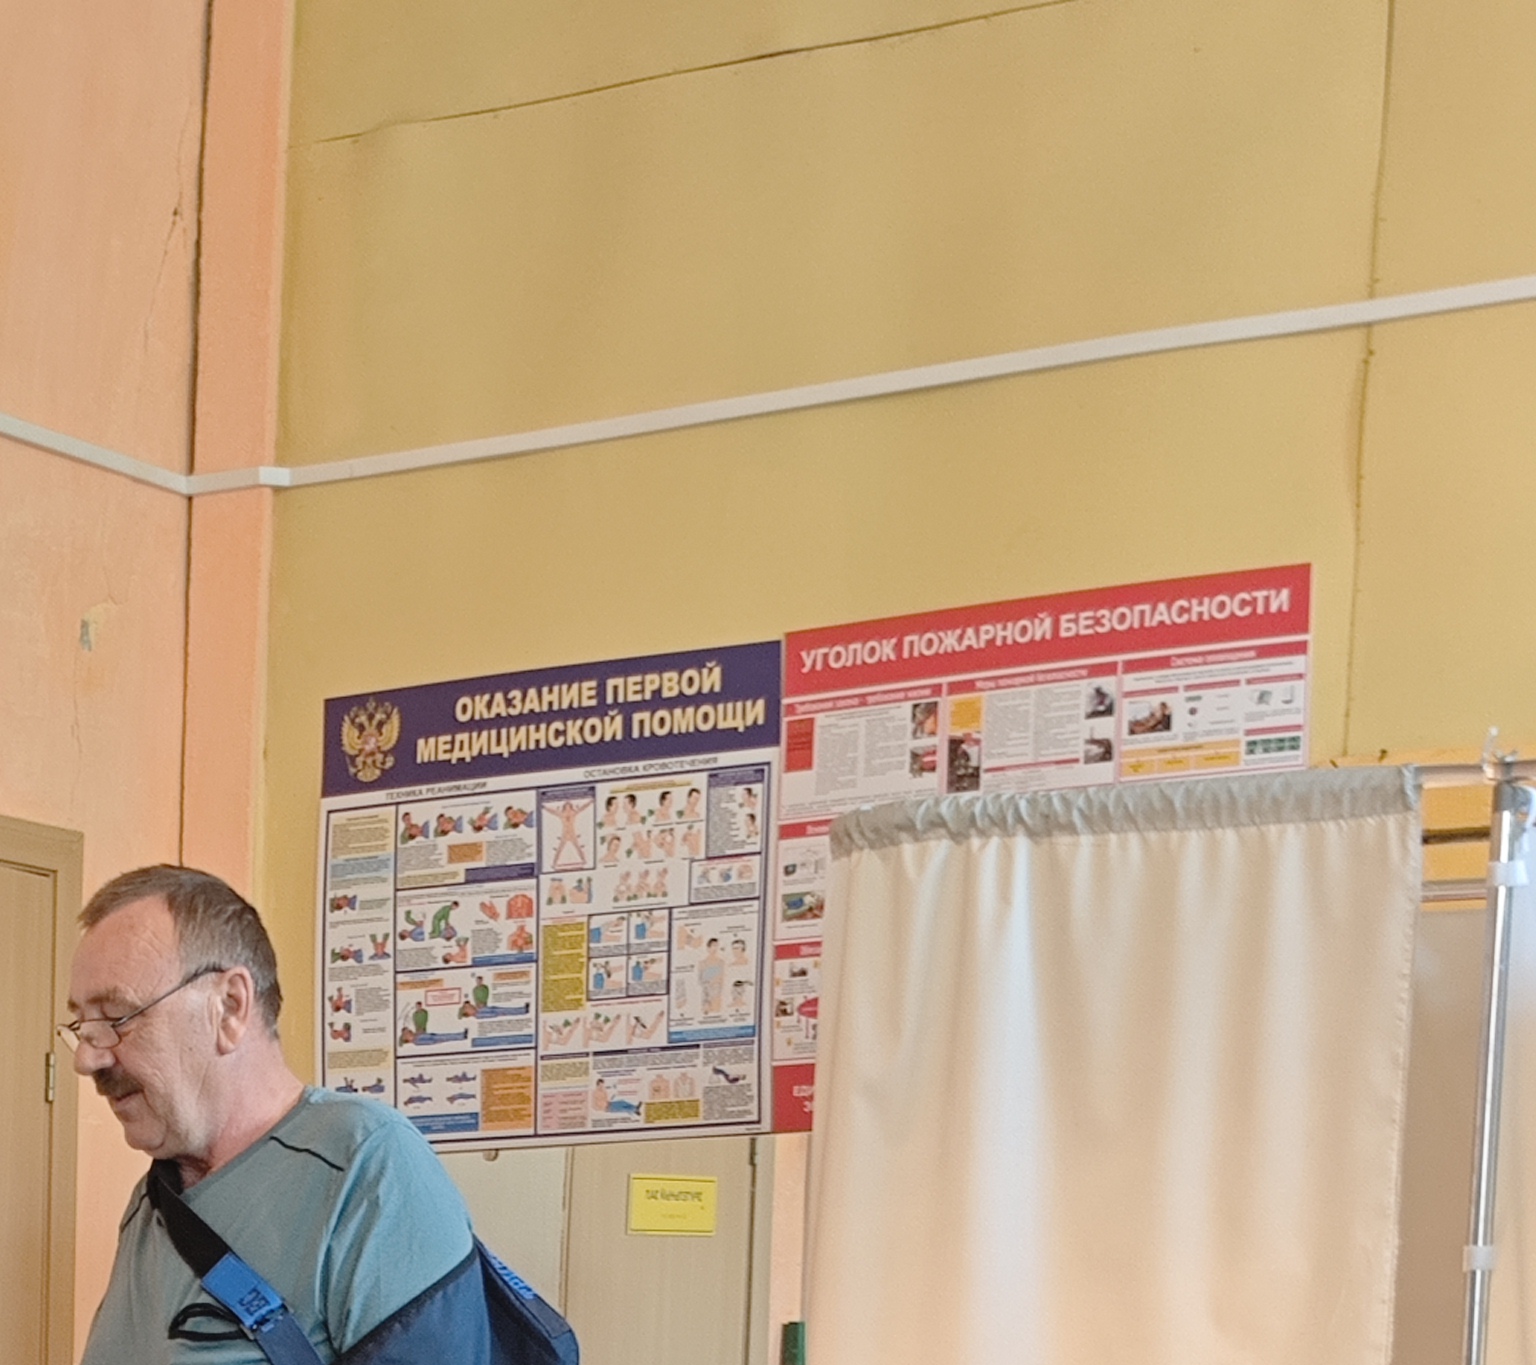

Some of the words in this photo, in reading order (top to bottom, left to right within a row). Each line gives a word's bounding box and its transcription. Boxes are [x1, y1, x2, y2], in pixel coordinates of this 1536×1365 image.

[800, 637, 896, 673] УГОЛОК
[902, 611, 1053, 661] ПОЖАРНОЙ
[1059, 587, 1292, 639] БЕЗОПАСНОСТИ
[454, 680, 598, 722] ОКАЗАНИЕ
[605, 660, 722, 705] ПЕРВОЙ
[415, 709, 624, 765] МЕДИЦИНСКОЙ
[631, 697, 766, 739] ПОМОЩИ
[584, 765, 640, 779] ОСТАНОВКА
